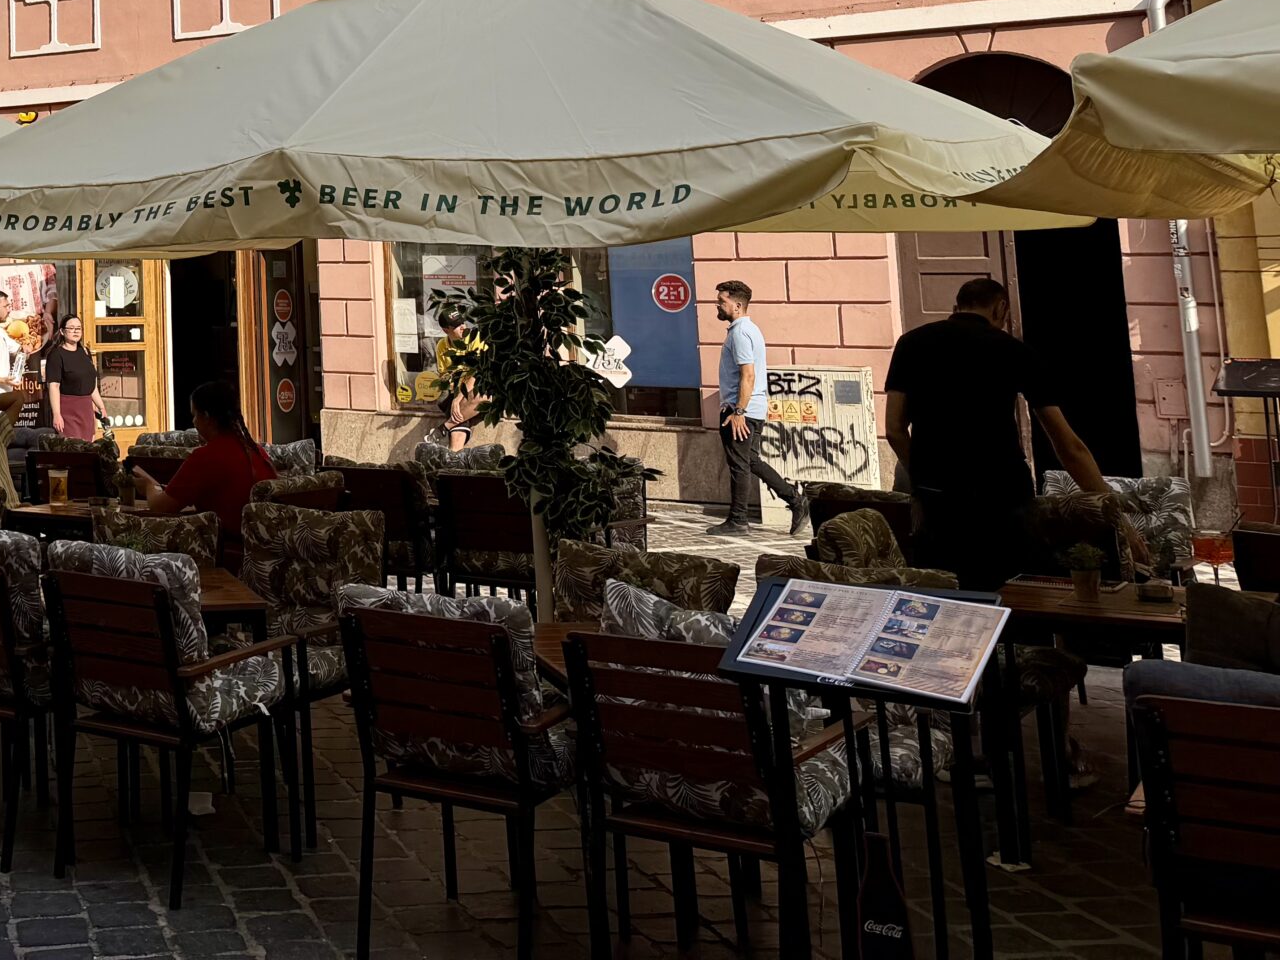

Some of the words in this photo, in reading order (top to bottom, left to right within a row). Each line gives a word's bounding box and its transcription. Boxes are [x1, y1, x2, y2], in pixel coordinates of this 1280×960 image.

[133, 201, 177, 224] THE
[185, 186, 253, 213] BEST
[319, 184, 402, 210] BEER
[420, 192, 459, 213] IN
[477, 194, 543, 216] THE
[564, 183, 692, 216] WORLD
